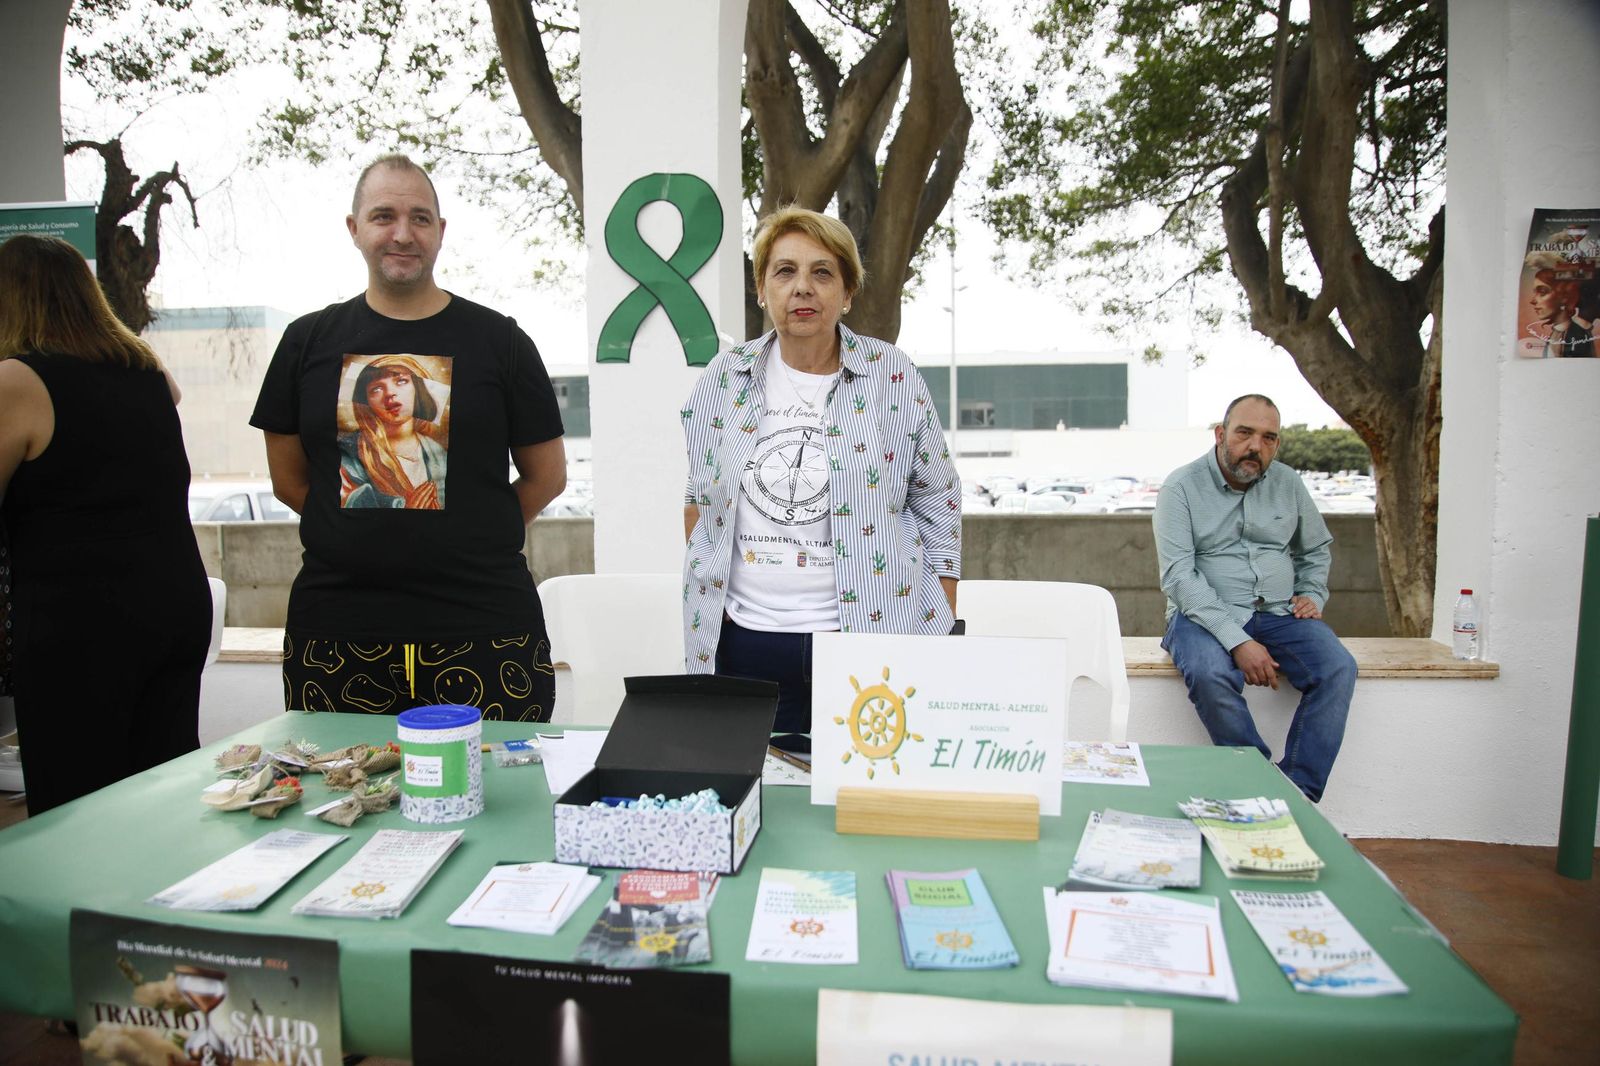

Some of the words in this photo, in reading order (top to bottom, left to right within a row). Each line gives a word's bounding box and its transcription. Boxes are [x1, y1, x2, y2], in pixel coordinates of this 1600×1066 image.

[28, 222, 45, 230] Salud
[50, 221, 79, 229] Consumo
[1530, 243, 1574, 251] TRABAJO
[802, 431, 812, 440] N
[785, 509, 795, 521] S
[928, 701, 960, 711] SALUD
[961, 702, 1001, 712] MENTAL
[930, 738, 963, 769] El
[973, 739, 1047, 774] Timón
[1235, 890, 1321, 901] ACTIVIDADES
[494, 965, 508, 975] TU
[510, 967, 542, 979] SALUD
[544, 969, 583, 983] MENTAL
[586, 974, 632, 986] IMPORTA
[91, 1002, 199, 1032] TRABAJO
[231, 1010, 318, 1047] SALUD
